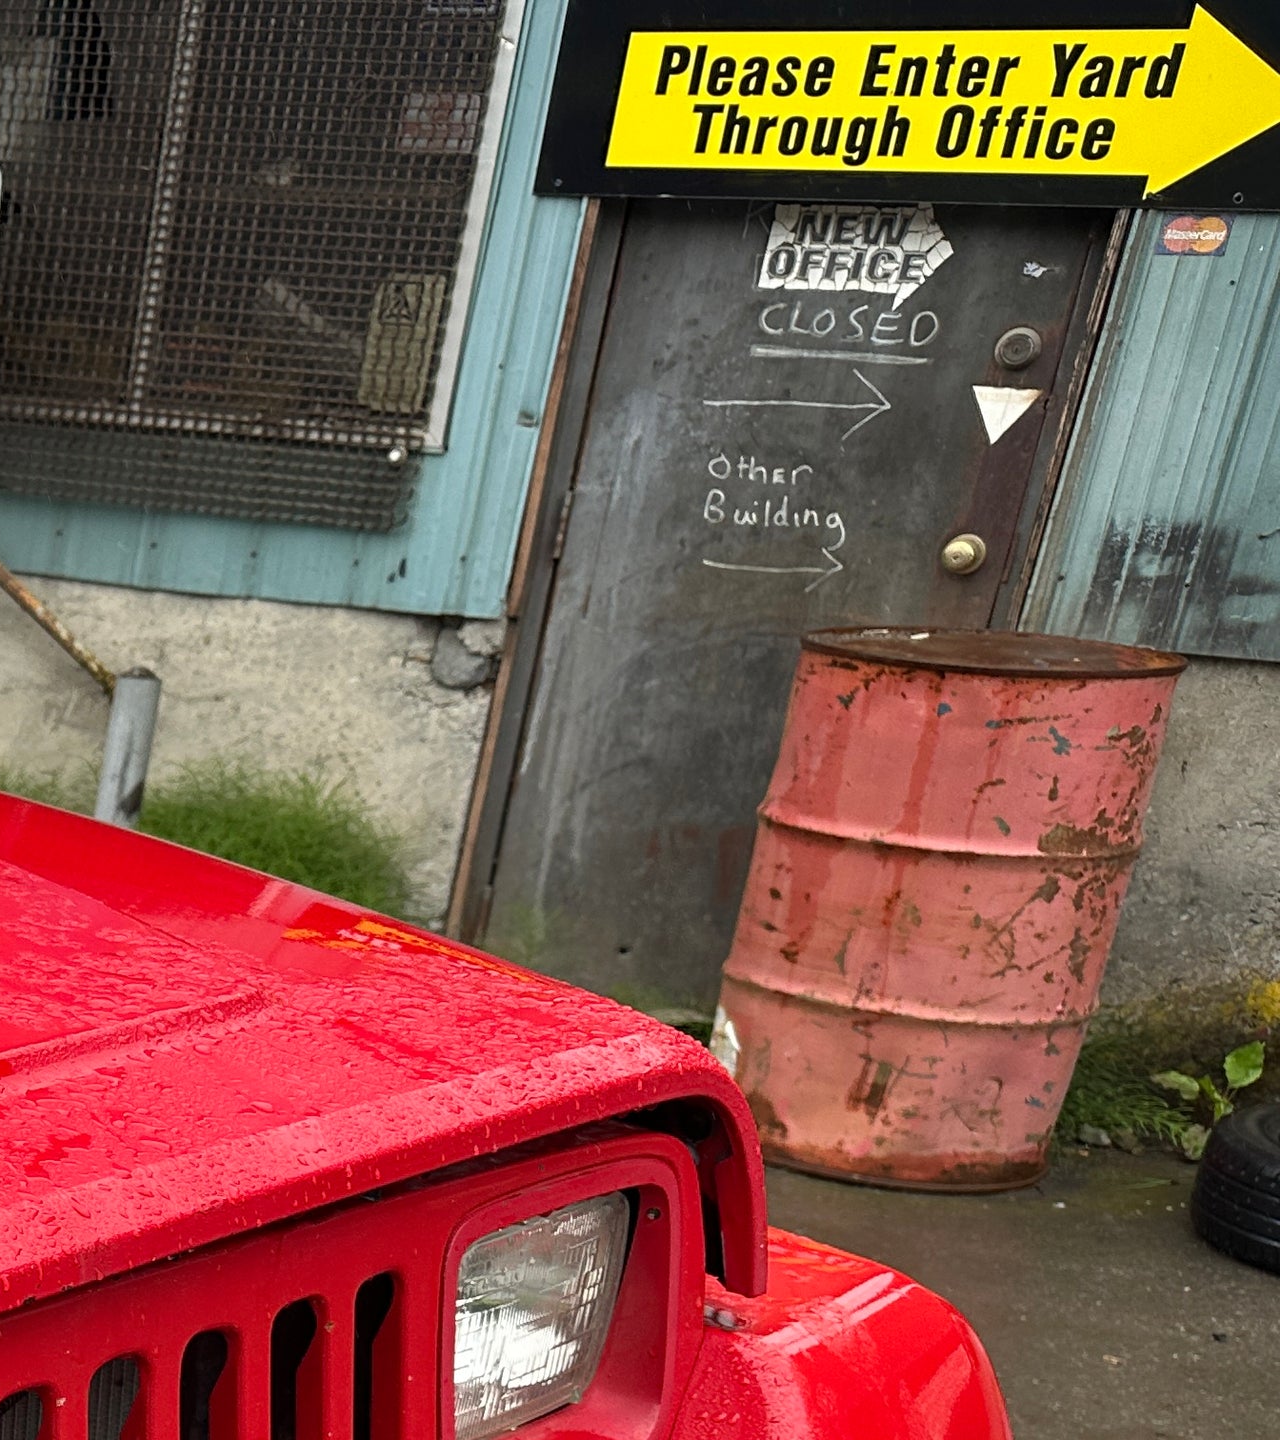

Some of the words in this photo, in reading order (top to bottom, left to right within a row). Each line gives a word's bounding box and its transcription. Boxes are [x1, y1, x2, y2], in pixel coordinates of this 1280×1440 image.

[655, 44, 835, 98] Please
[859, 45, 1019, 98] Enter
[1050, 43, 1186, 99] Yard
[692, 104, 911, 166] Through
[936, 105, 1116, 161] Office
[795, 209, 911, 246] NEW
[767, 243, 928, 284] OFFICE
[759, 300, 939, 346] CLOSED
[708, 452, 813, 485] Other
[703, 488, 846, 551] Building
